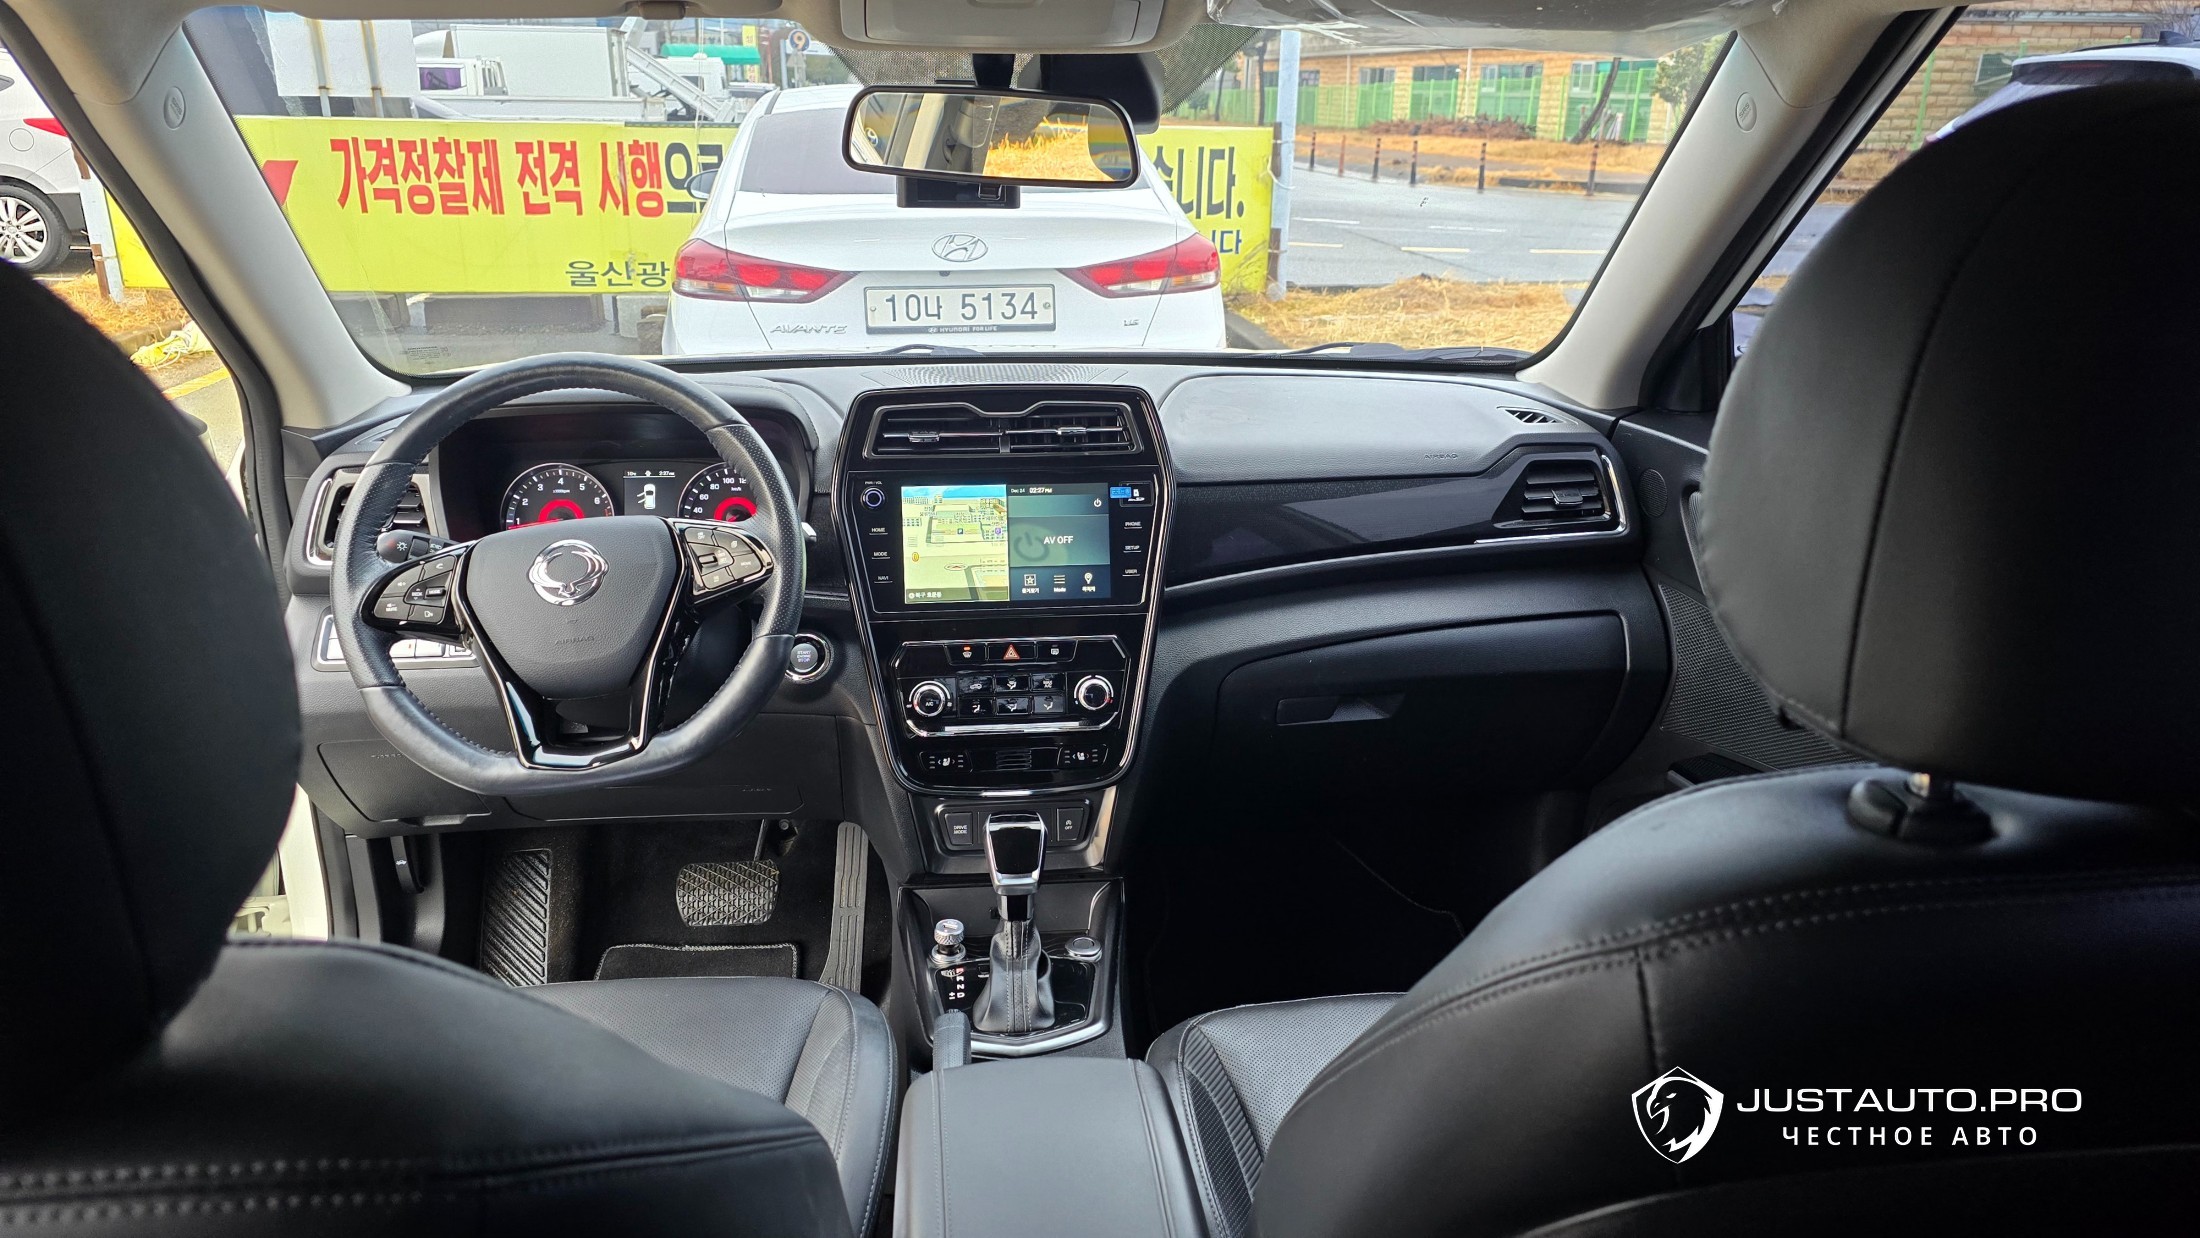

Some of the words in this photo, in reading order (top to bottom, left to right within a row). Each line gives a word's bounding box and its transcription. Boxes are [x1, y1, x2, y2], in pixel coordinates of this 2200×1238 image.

[792, 31, 806, 50] 9
[330, 136, 505, 216] 가격정찰제
[515, 139, 584, 217] 전격
[885, 293, 943, 322] 10나
[960, 291, 1039, 321] 5134
[770, 324, 848, 335] AVANTE
[579, 483, 586, 491] 5
[522, 498, 529, 506] 2
[594, 497, 601, 505] 6
[693, 506, 703, 514] 40
[1043, 536, 1056, 544] AV
[1057, 536, 1074, 544] OFF
